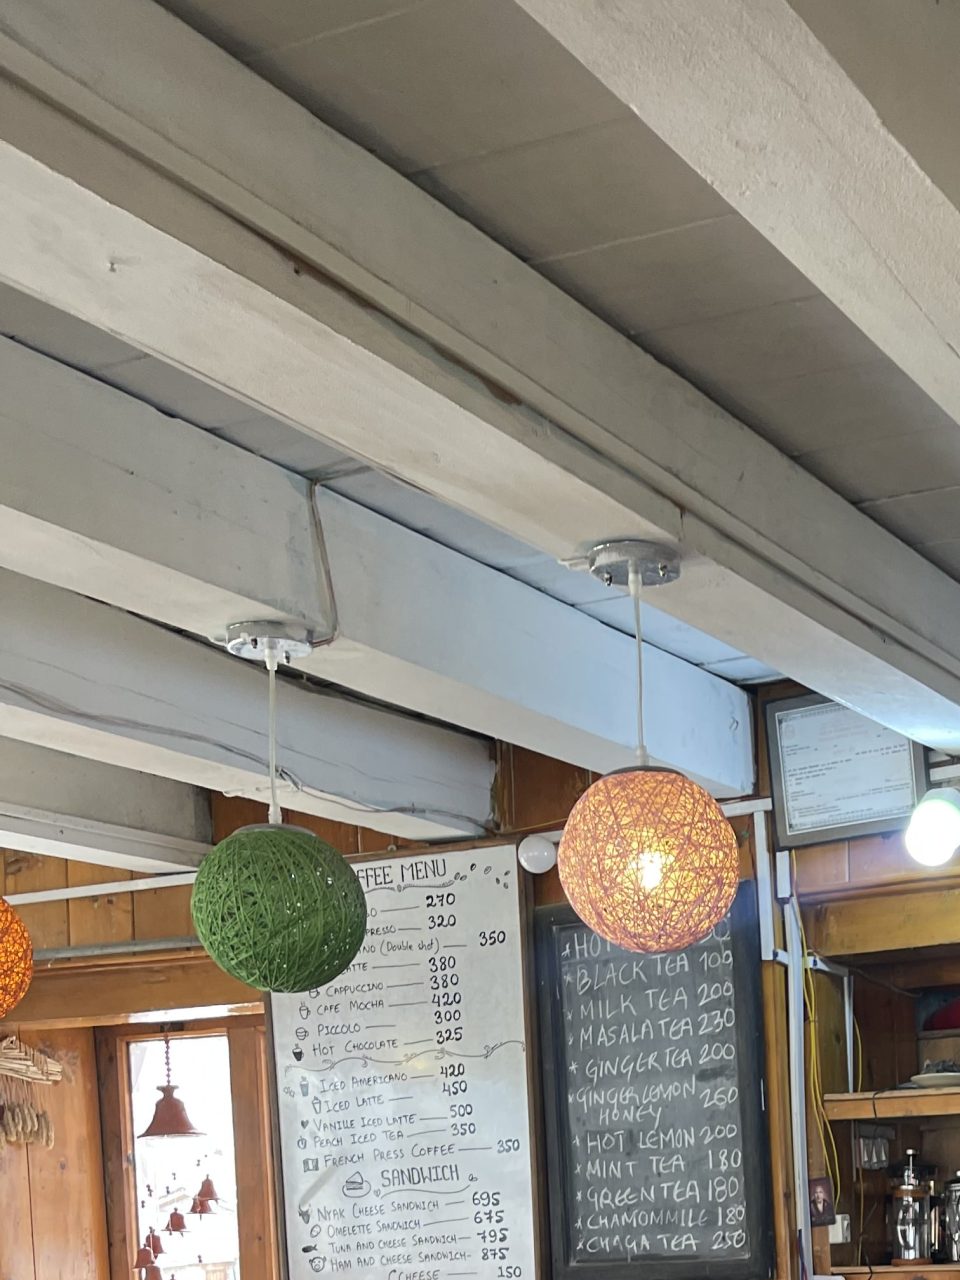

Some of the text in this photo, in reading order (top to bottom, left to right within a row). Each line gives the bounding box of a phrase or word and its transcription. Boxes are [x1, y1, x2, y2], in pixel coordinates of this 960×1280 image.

[401, 859, 447, 883] MENU
[426, 893, 455, 907] 270
[365, 915, 456, 935] PRESSO 320
[380, 940, 415, 956] (Double
[479, 931, 506, 947] 350
[429, 956, 456, 972] 380
[576, 960, 648, 995] BLACK
[652, 953, 689, 976] TEA
[326, 974, 459, 997] CAPPUCCINO 380
[317, 993, 462, 1015] CAFE MOCHA 420
[581, 982, 732, 1020] MILK TEA 200
[318, 1010, 461, 1036] PICCOLO 300
[580, 1008, 735, 1049] MASALA TEA 230
[312, 1027, 462, 1057] HOT CHOCOLATE 325
[586, 1044, 735, 1085] GINGER TEA 200
[320, 1064, 464, 1093] ICED AMERICANO 420
[327, 1082, 467, 1113] ICED LATTE 450
[576, 1075, 738, 1113] GINGER LEMON 260
[361, 1116, 382, 1128] ICED
[386, 1115, 416, 1125] LATTE
[450, 1105, 472, 1118] 500
[600, 1105, 661, 1128] HONEY
[313, 1123, 475, 1148] PEACH ICED TEA 350
[587, 1124, 737, 1153] HOT LEMON 200
[324, 1139, 520, 1168] FRENCH PRESS COFFEE 350
[586, 1149, 741, 1180] MINT TEA 180
[381, 1165, 459, 1187] SANDWICH
[352, 1204, 385, 1218] CHEESE
[391, 1200, 439, 1212] SANDWICH
[472, 1192, 500, 1206] 695
[587, 1177, 738, 1210] GREEN TEA 180
[327, 1210, 504, 1237] OMELETTE SANDWICH 675
[718, 1207, 744, 1226] 180
[328, 1228, 508, 1254] TUNA AND CHEESE SANDWICH 795
[587, 1230, 745, 1253] CHAGA TEA 250
[331, 1248, 509, 1272] HAM AND CHEESE SANDWICH 875
[498, 1266, 521, 1278] 150
